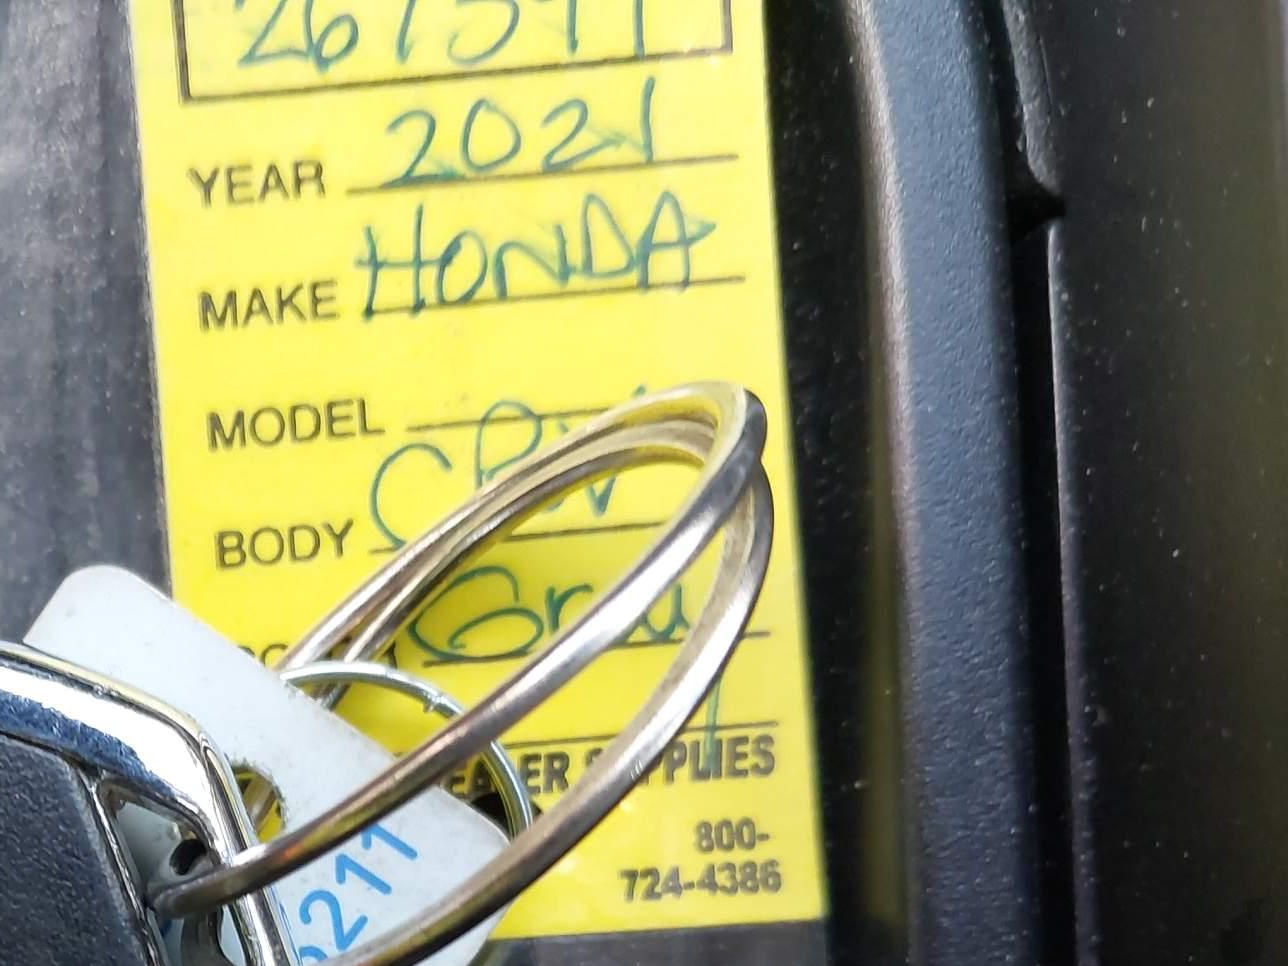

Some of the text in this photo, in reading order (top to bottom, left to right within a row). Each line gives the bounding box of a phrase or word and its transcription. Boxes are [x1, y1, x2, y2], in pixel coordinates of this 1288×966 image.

[382, 76, 657, 189] 2021
[190, 159, 326, 206] YEAR
[355, 190, 716, 322] HONDA
[198, 279, 340, 331] MAKE
[207, 398, 386, 452] MODEL
[214, 519, 355, 569] BODY
[694, 817, 771, 853] 800-
[619, 859, 783, 901] 724-4386
